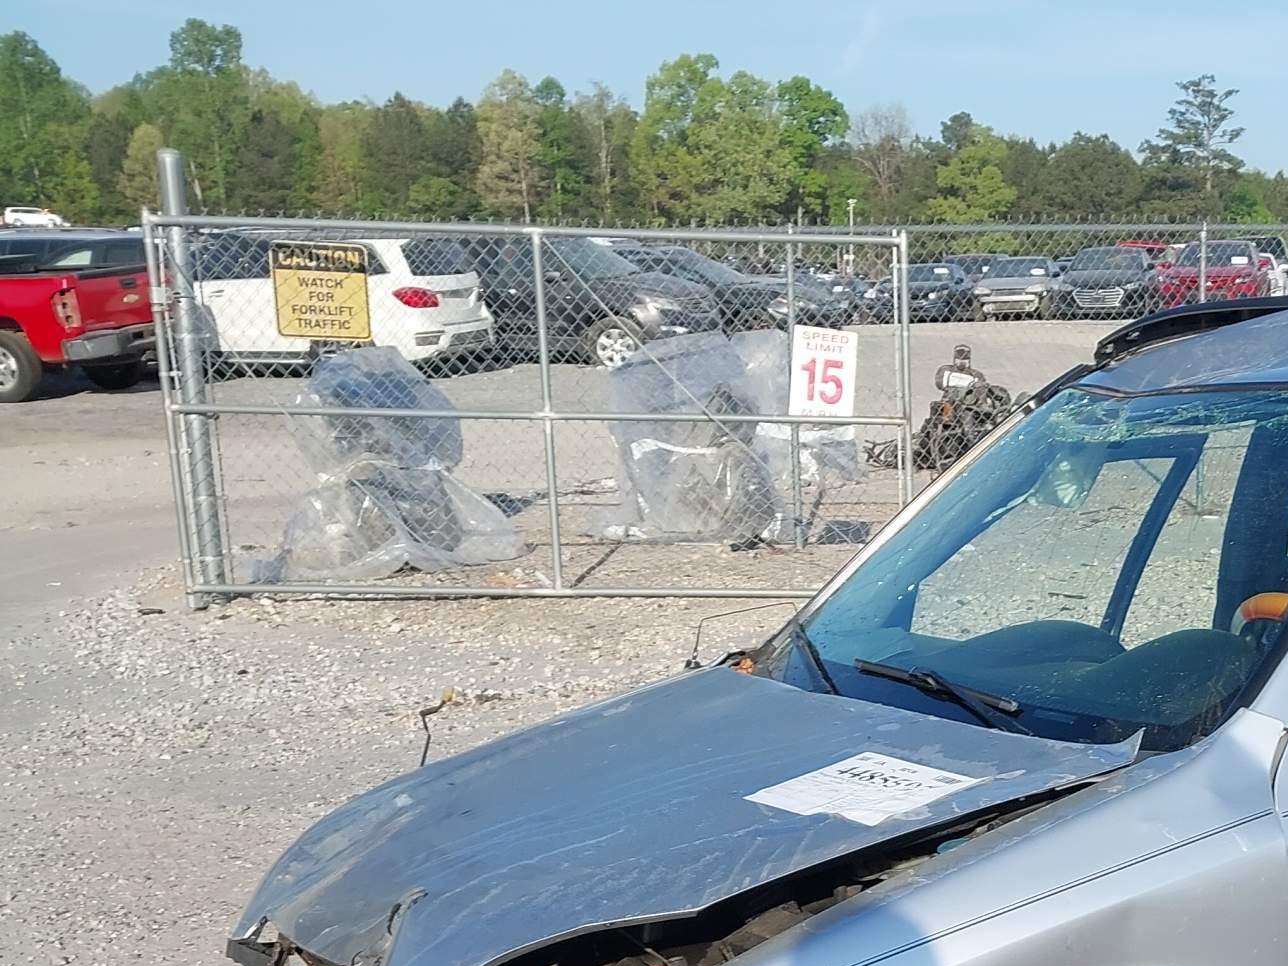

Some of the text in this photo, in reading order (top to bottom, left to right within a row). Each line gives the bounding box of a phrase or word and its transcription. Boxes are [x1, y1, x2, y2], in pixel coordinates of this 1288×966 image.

[277, 247, 360, 267] CAUTION
[297, 277, 344, 289] WATCH
[308, 291, 335, 302] FOR
[291, 304, 354, 317] FORKLIFT
[295, 318, 352, 330] TRAFFIC
[802, 331, 849, 344] SPEED
[806, 342, 845, 353] LIMIT
[800, 357, 844, 405] 15
